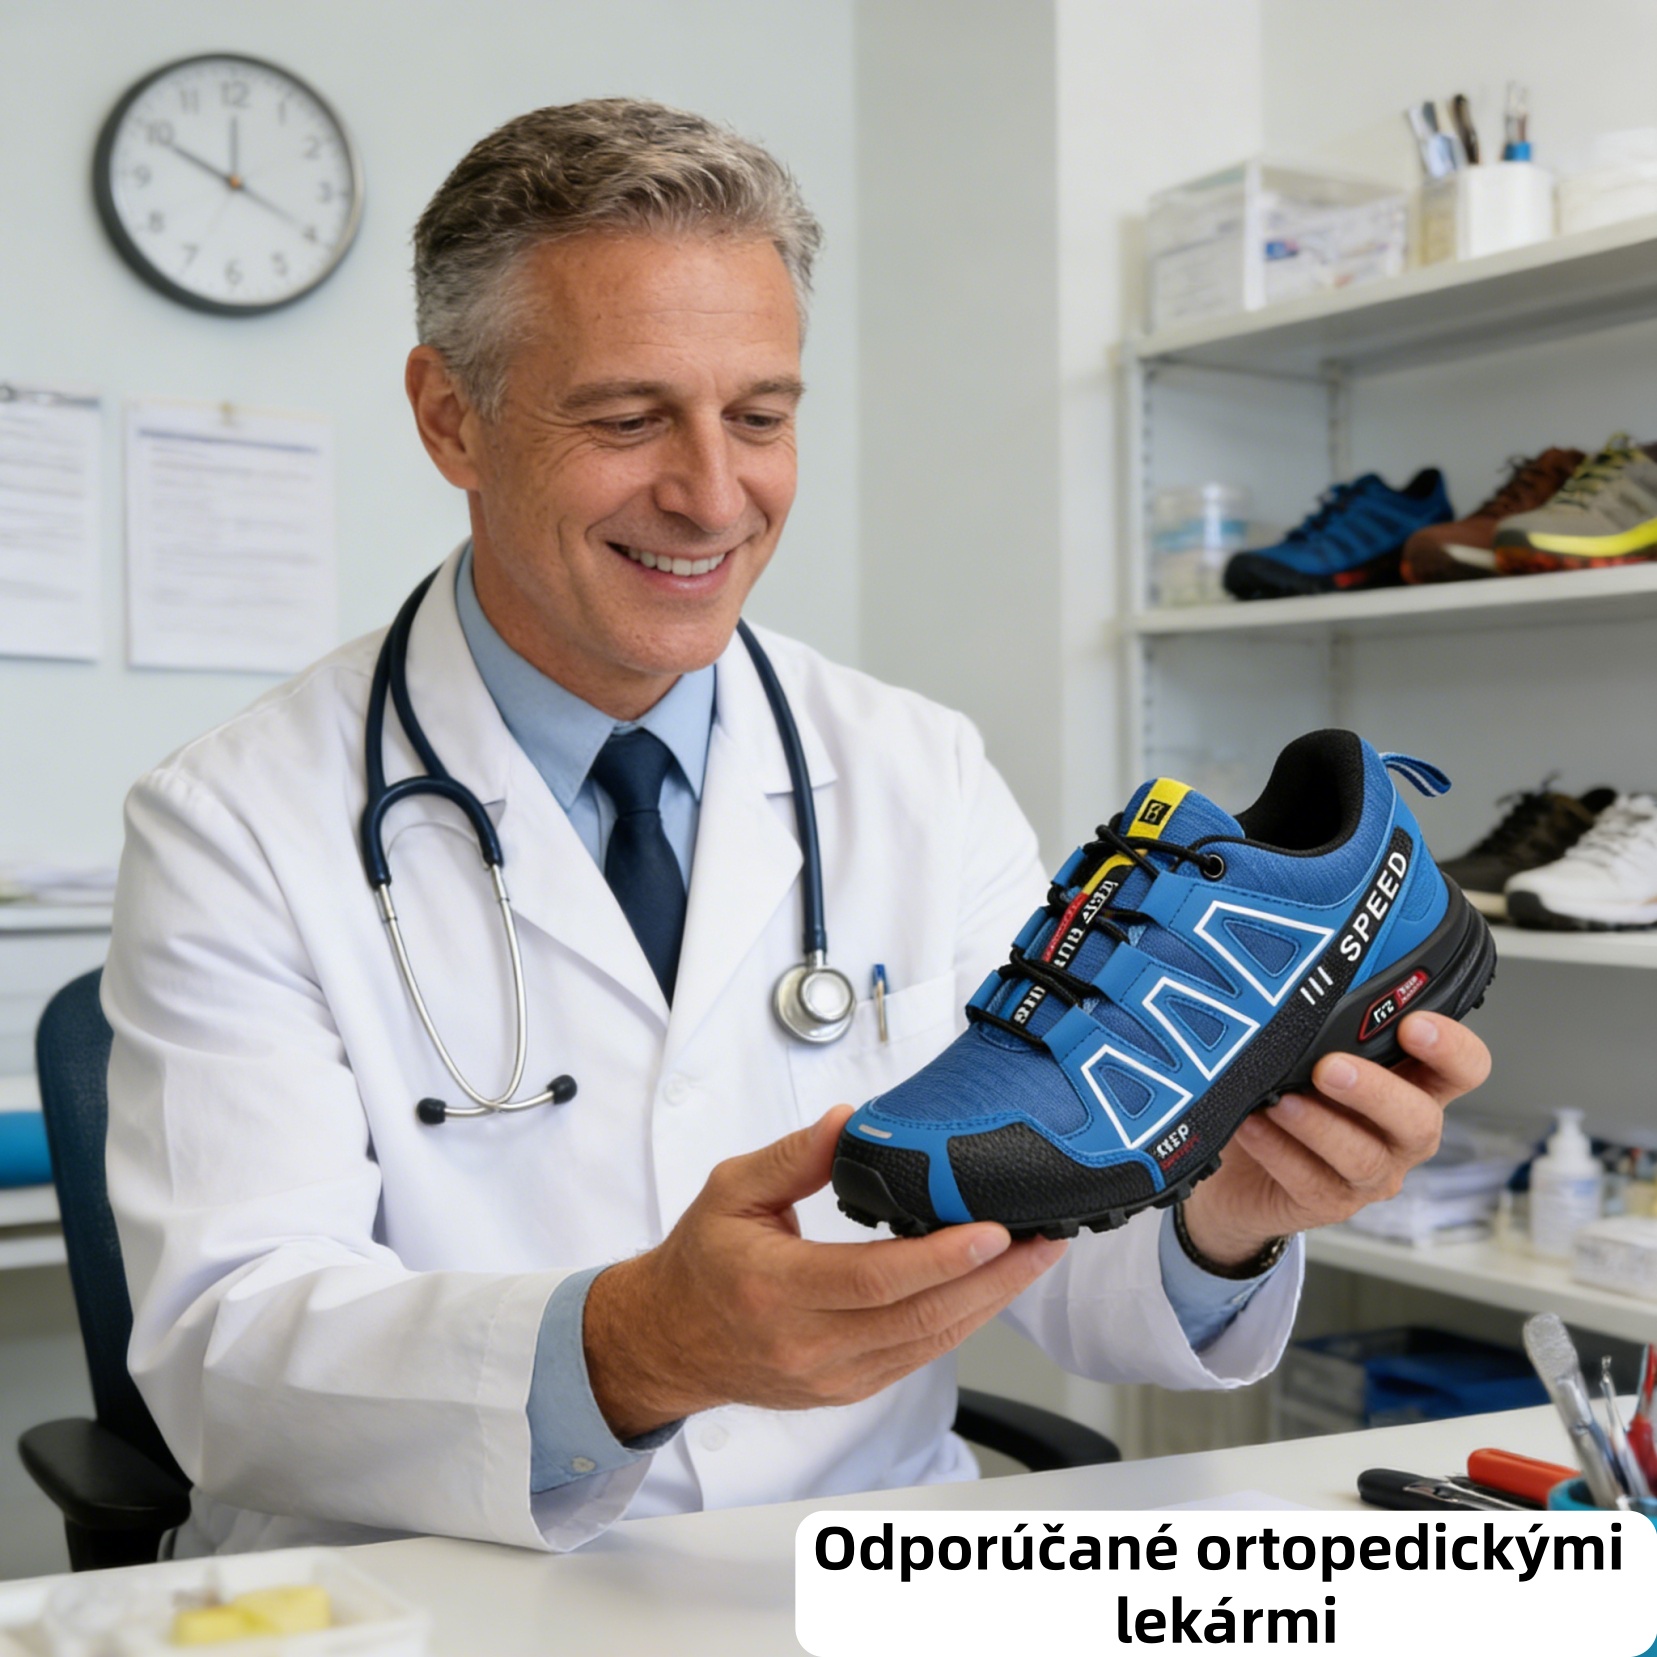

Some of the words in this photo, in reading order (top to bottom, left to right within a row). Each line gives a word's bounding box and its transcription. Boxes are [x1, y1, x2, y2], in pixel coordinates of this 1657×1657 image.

[180, 88, 200, 114] 11
[220, 80, 249, 107] 12
[148, 121, 174, 145] 10
[304, 136, 321, 160] 2
[132, 165, 151, 188] 9
[319, 181, 333, 204] 3
[148, 211, 165, 233] 8
[303, 225, 317, 244] 4
[183, 243, 200, 266] 7
[224, 260, 242, 286] 6
[1340, 851, 1407, 962] SPEED
